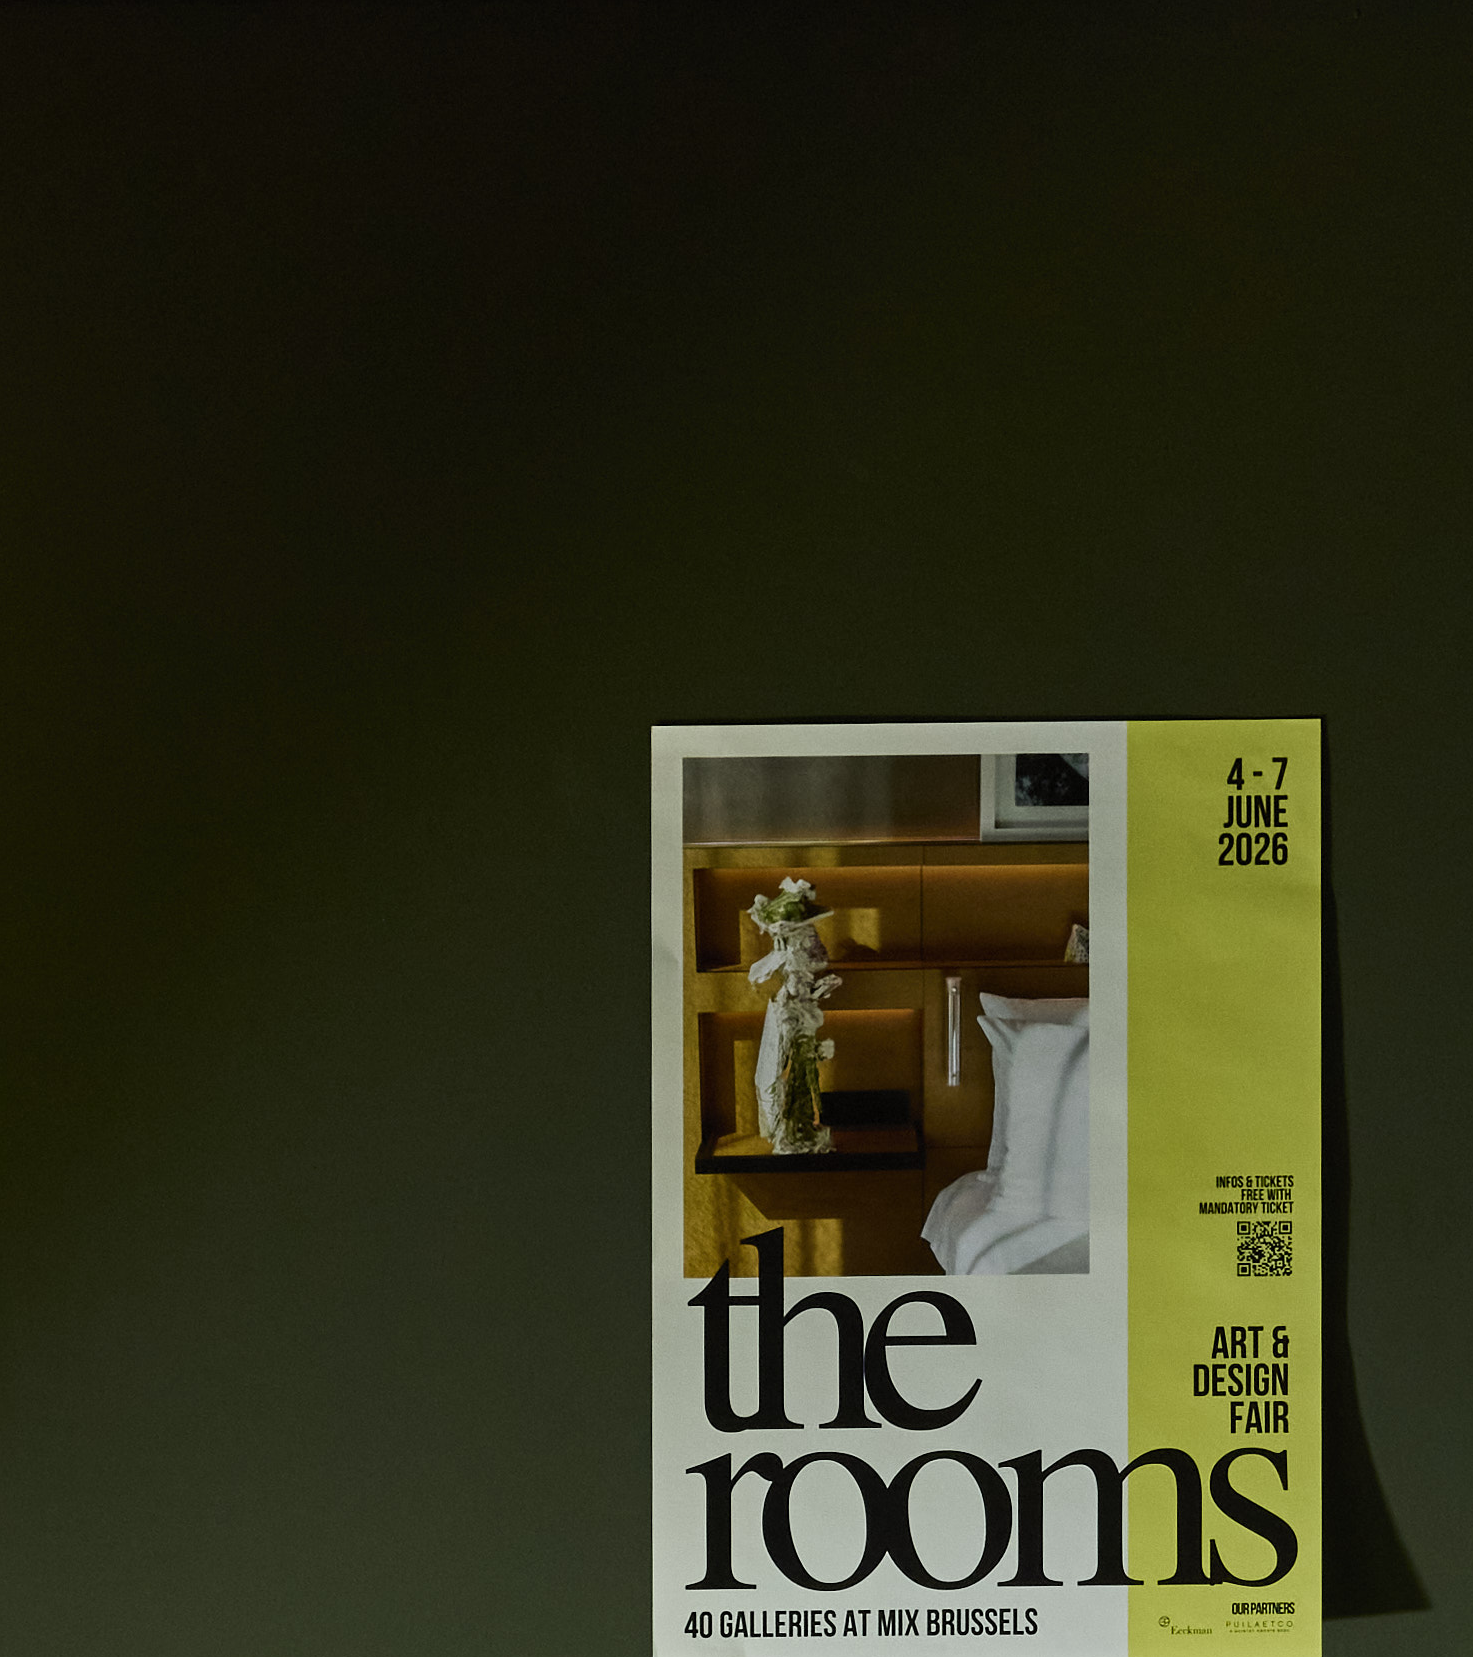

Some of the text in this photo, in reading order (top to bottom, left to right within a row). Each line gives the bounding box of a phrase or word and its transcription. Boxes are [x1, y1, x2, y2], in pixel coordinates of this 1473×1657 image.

[1227, 758, 1244, 790] 4
[1272, 757, 1287, 790] 7
[1223, 795, 1288, 828] JUNE
[1219, 833, 1288, 866] 2026
[1216, 1175, 1294, 1188] INFOS & TICKETS
[1241, 1189, 1291, 1200] FREE WITH
[1199, 1201, 1294, 1214] MANDATORY TICKET
[687, 1226, 983, 1433] the
[1212, 1326, 1289, 1359] ART &
[1194, 1363, 1288, 1396] DESIGN
[1231, 1401, 1288, 1433] FAIR
[685, 1448, 1299, 1591] rooms
[685, 1608, 1037, 1638] 40 GALLERIES AT MIX BRUSSELS
[1226, 1620, 1294, 1628] PUILAETCO
[1231, 1602, 1294, 1614] OUR PARTNERS
